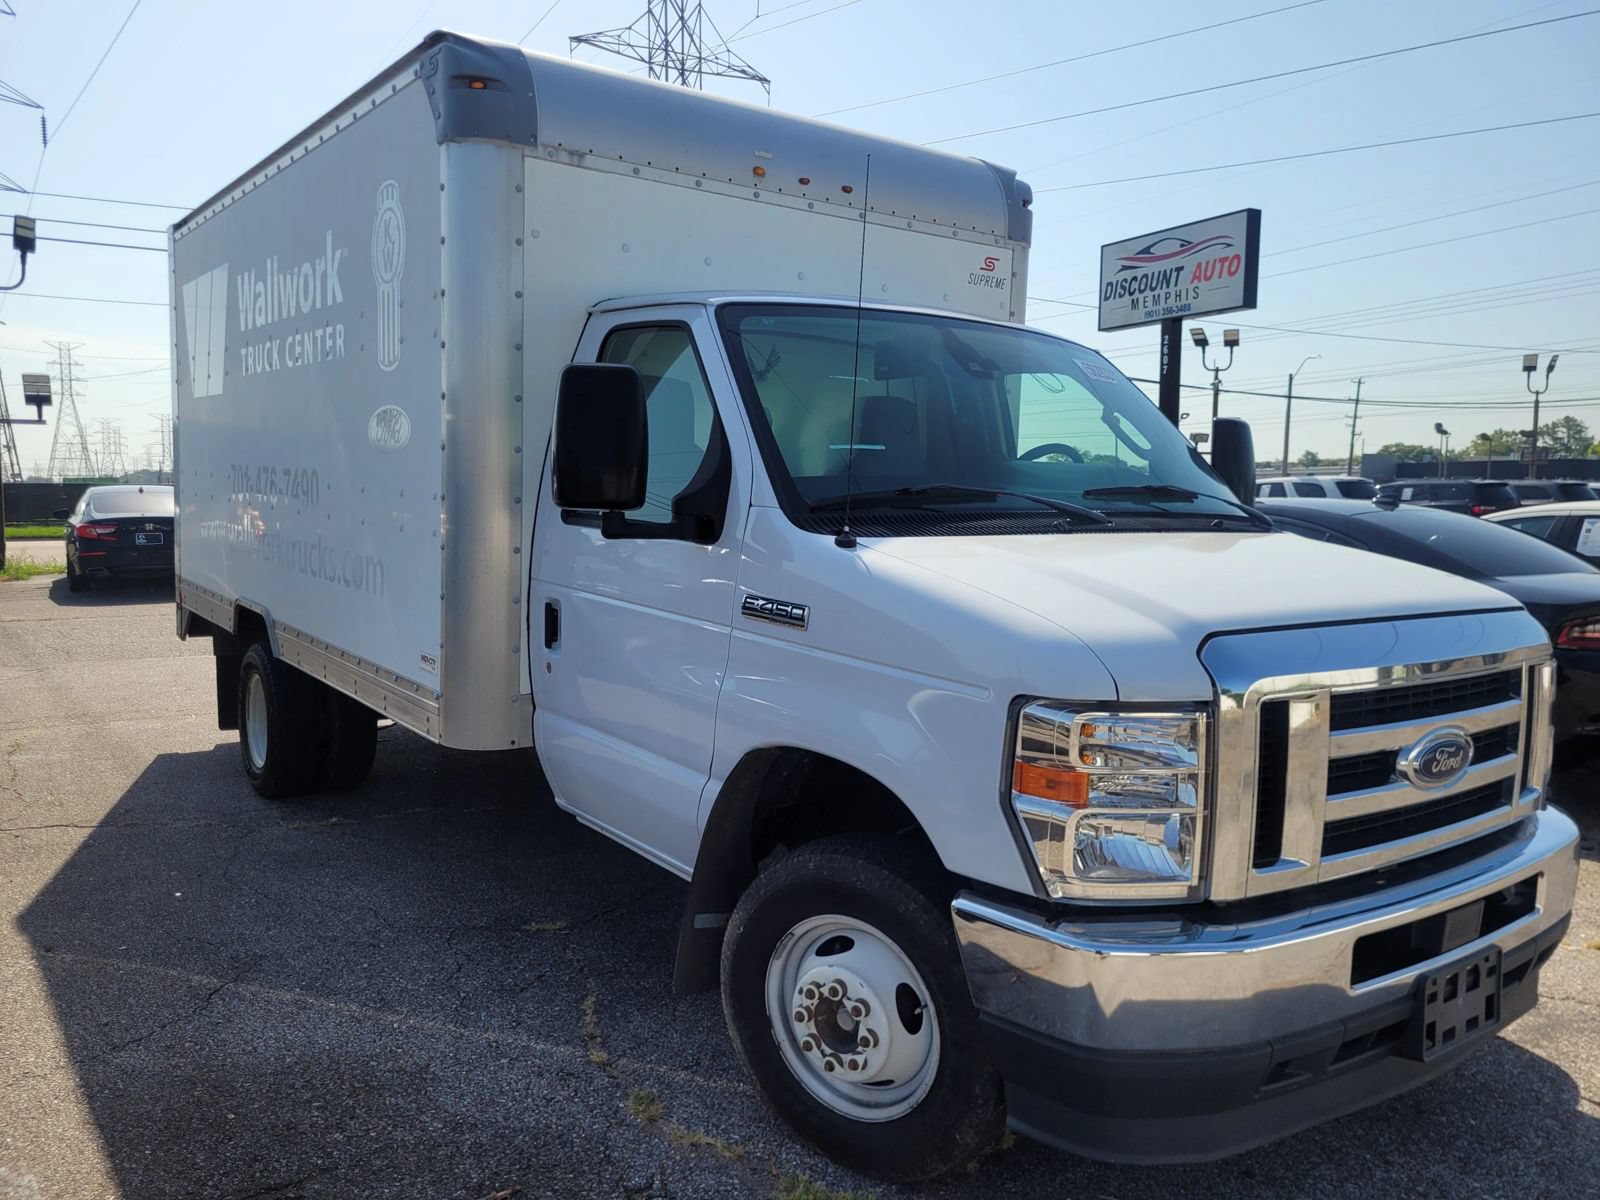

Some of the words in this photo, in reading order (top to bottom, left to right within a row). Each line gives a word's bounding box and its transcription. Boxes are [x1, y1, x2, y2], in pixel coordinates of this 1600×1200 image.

[237, 230, 344, 332] Wallwork
[968, 272, 1007, 290] SUPREME
[1103, 265, 1185, 302] DISCOUNT
[1190, 253, 1242, 285] AUTO
[1130, 286, 1200, 311] MEMPHIS
[1144, 309, 1160, 319] (901)
[240, 339, 280, 377] TRUCK
[286, 324, 345, 368] CENTER
[1162, 335, 1170, 375] 2607
[1431, 746, 1464, 773] Ford
